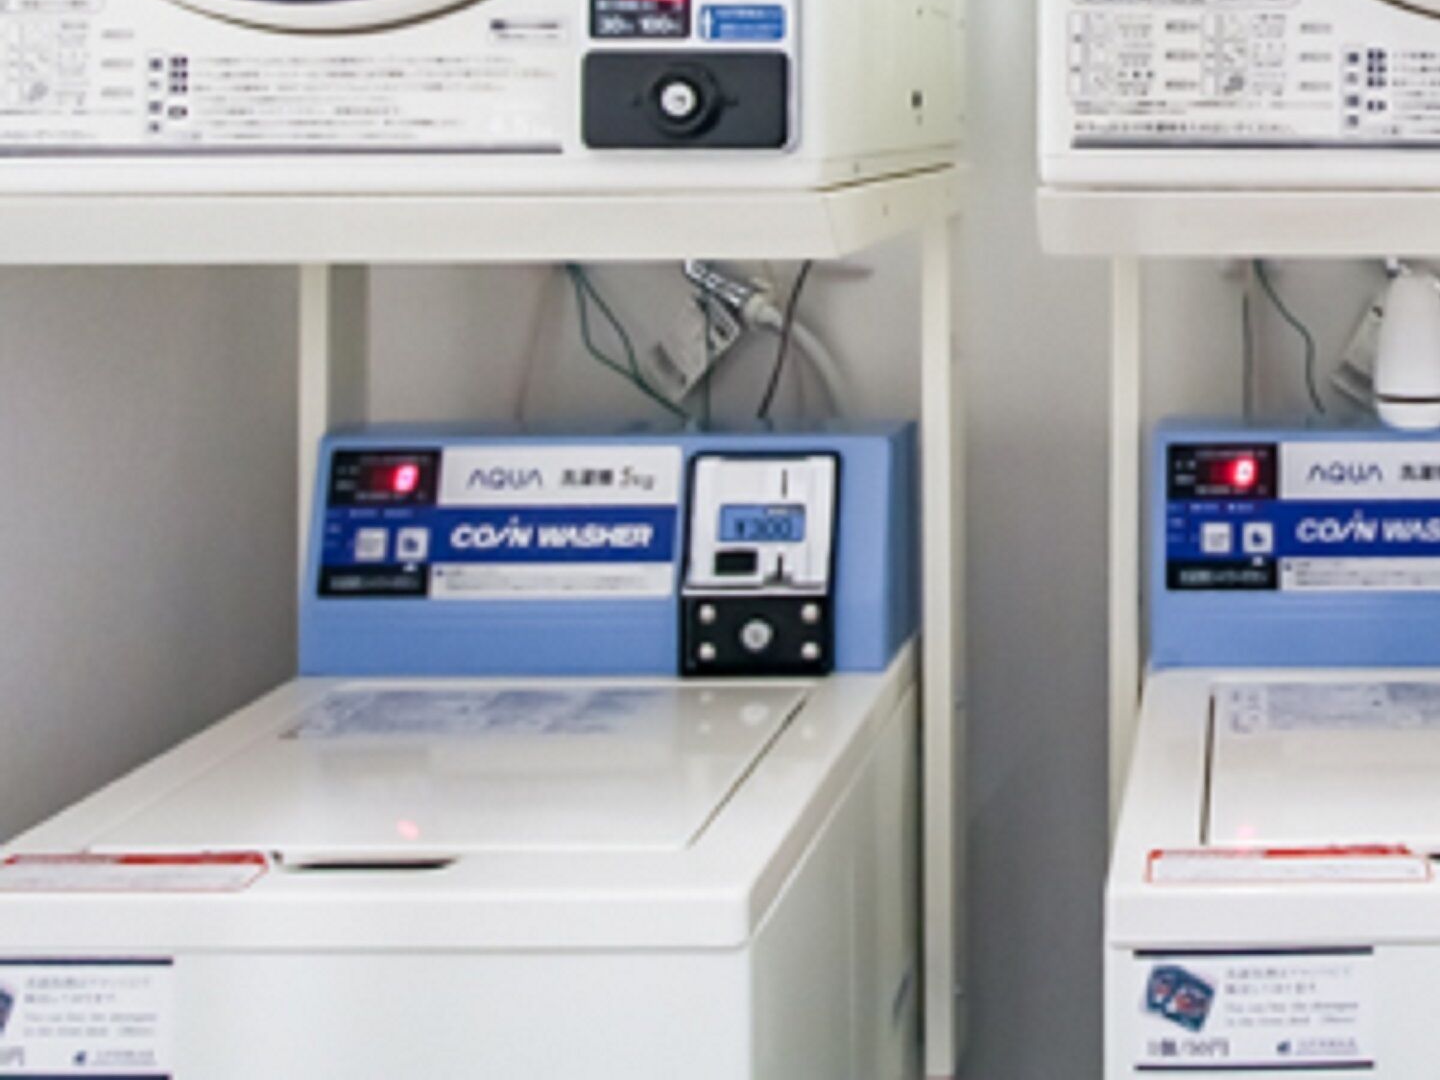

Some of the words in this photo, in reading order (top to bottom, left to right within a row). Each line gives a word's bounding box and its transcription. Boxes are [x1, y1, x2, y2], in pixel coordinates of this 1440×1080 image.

[467, 467, 543, 490] AQUA
[1307, 461, 1383, 484] AQUA
[451, 516, 533, 548] COIN
[537, 523, 654, 548] WASHER
[1296, 509, 1378, 542] COIN
